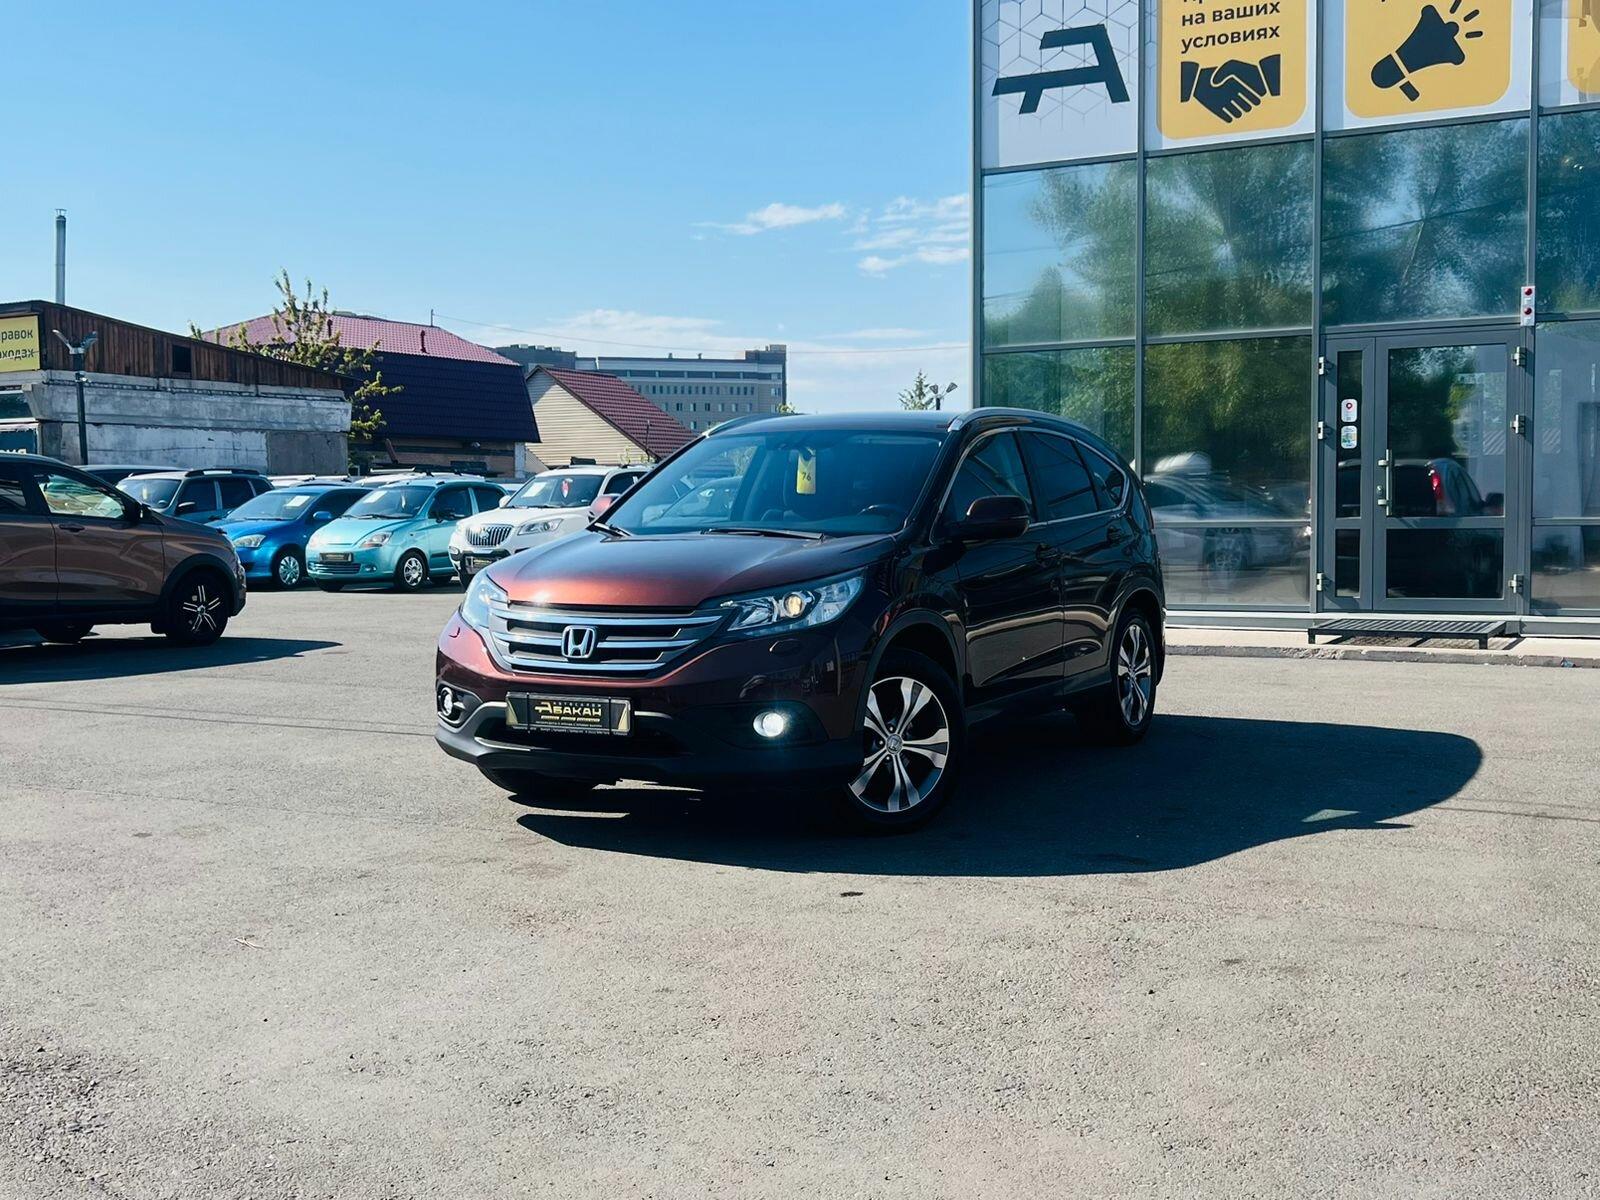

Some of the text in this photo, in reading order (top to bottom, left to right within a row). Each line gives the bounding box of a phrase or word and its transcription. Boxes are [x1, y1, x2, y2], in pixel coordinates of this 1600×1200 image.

[1181, 2, 1281, 27] на ваших
[1180, 25, 1281, 54] условиях
[802, 471, 812, 482] 76
